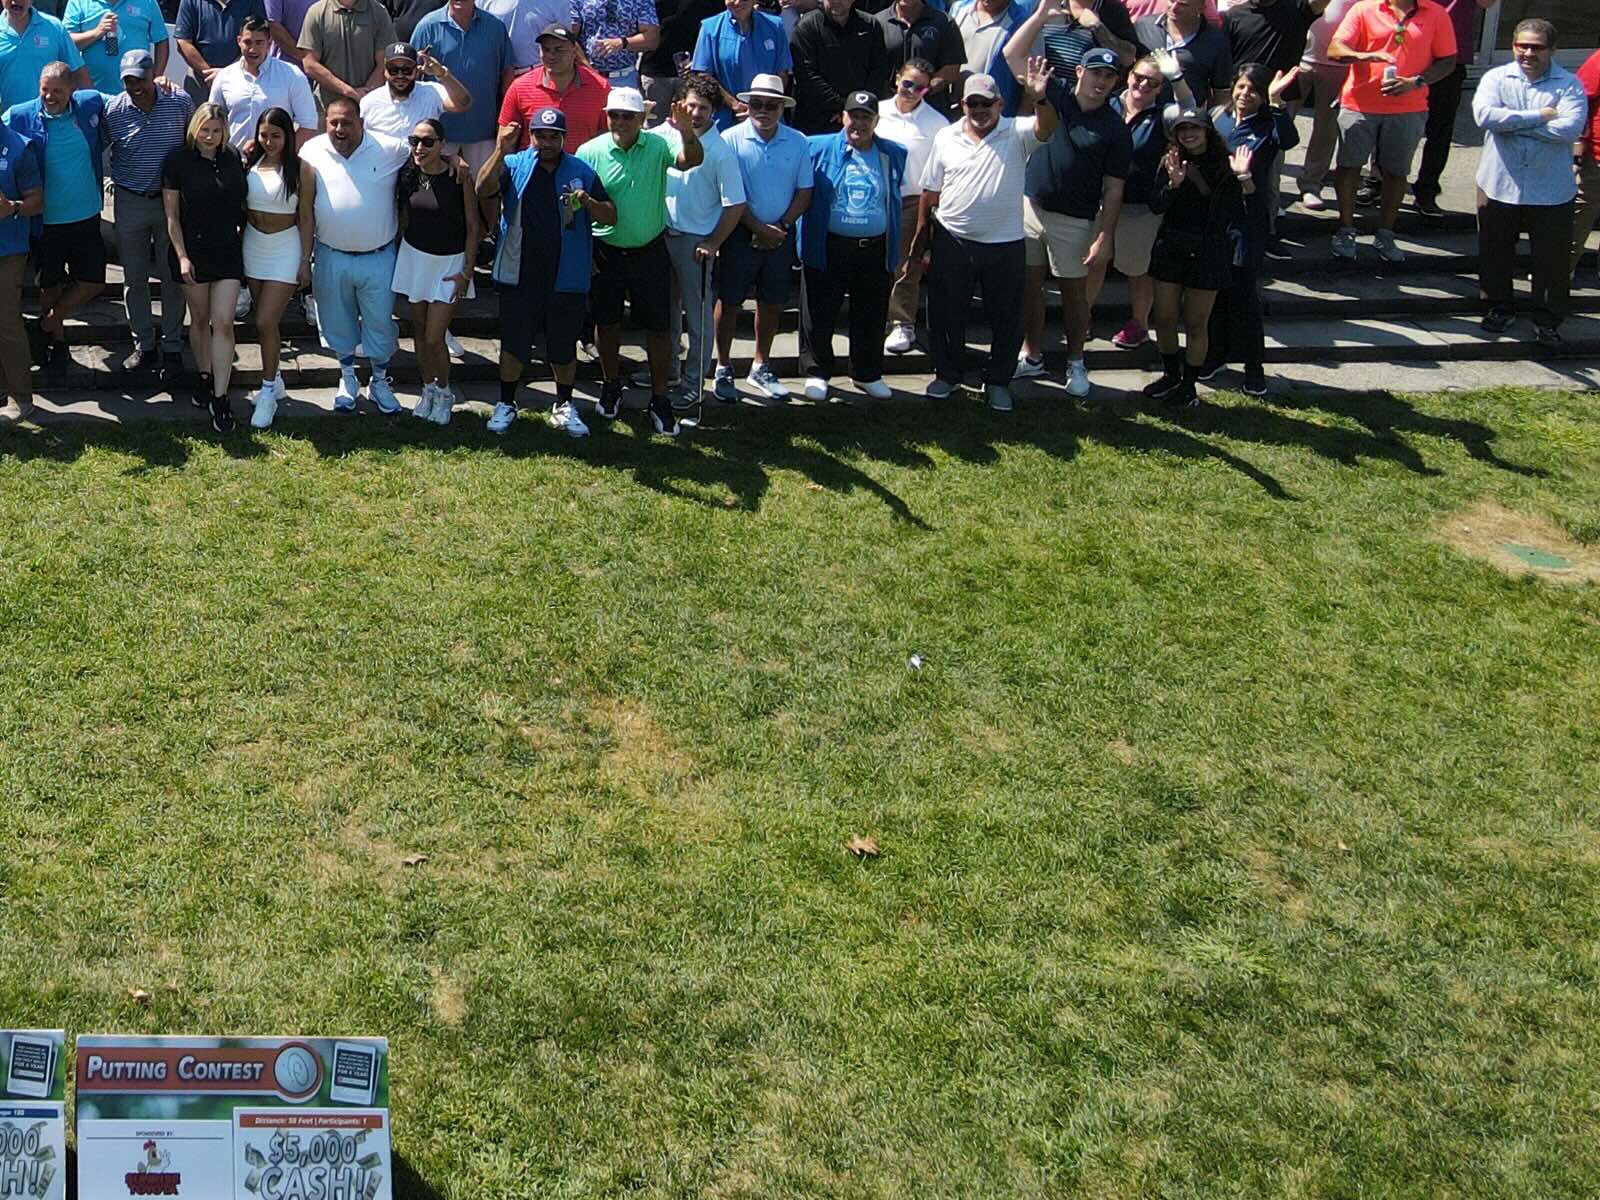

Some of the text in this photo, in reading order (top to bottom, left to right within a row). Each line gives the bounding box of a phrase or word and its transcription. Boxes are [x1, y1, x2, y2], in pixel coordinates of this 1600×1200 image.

[87, 1055, 264, 1080] PUTTING CONTEST
[268, 1131, 357, 1167] $5,000
[260, 1166, 366, 1200] CASH!
